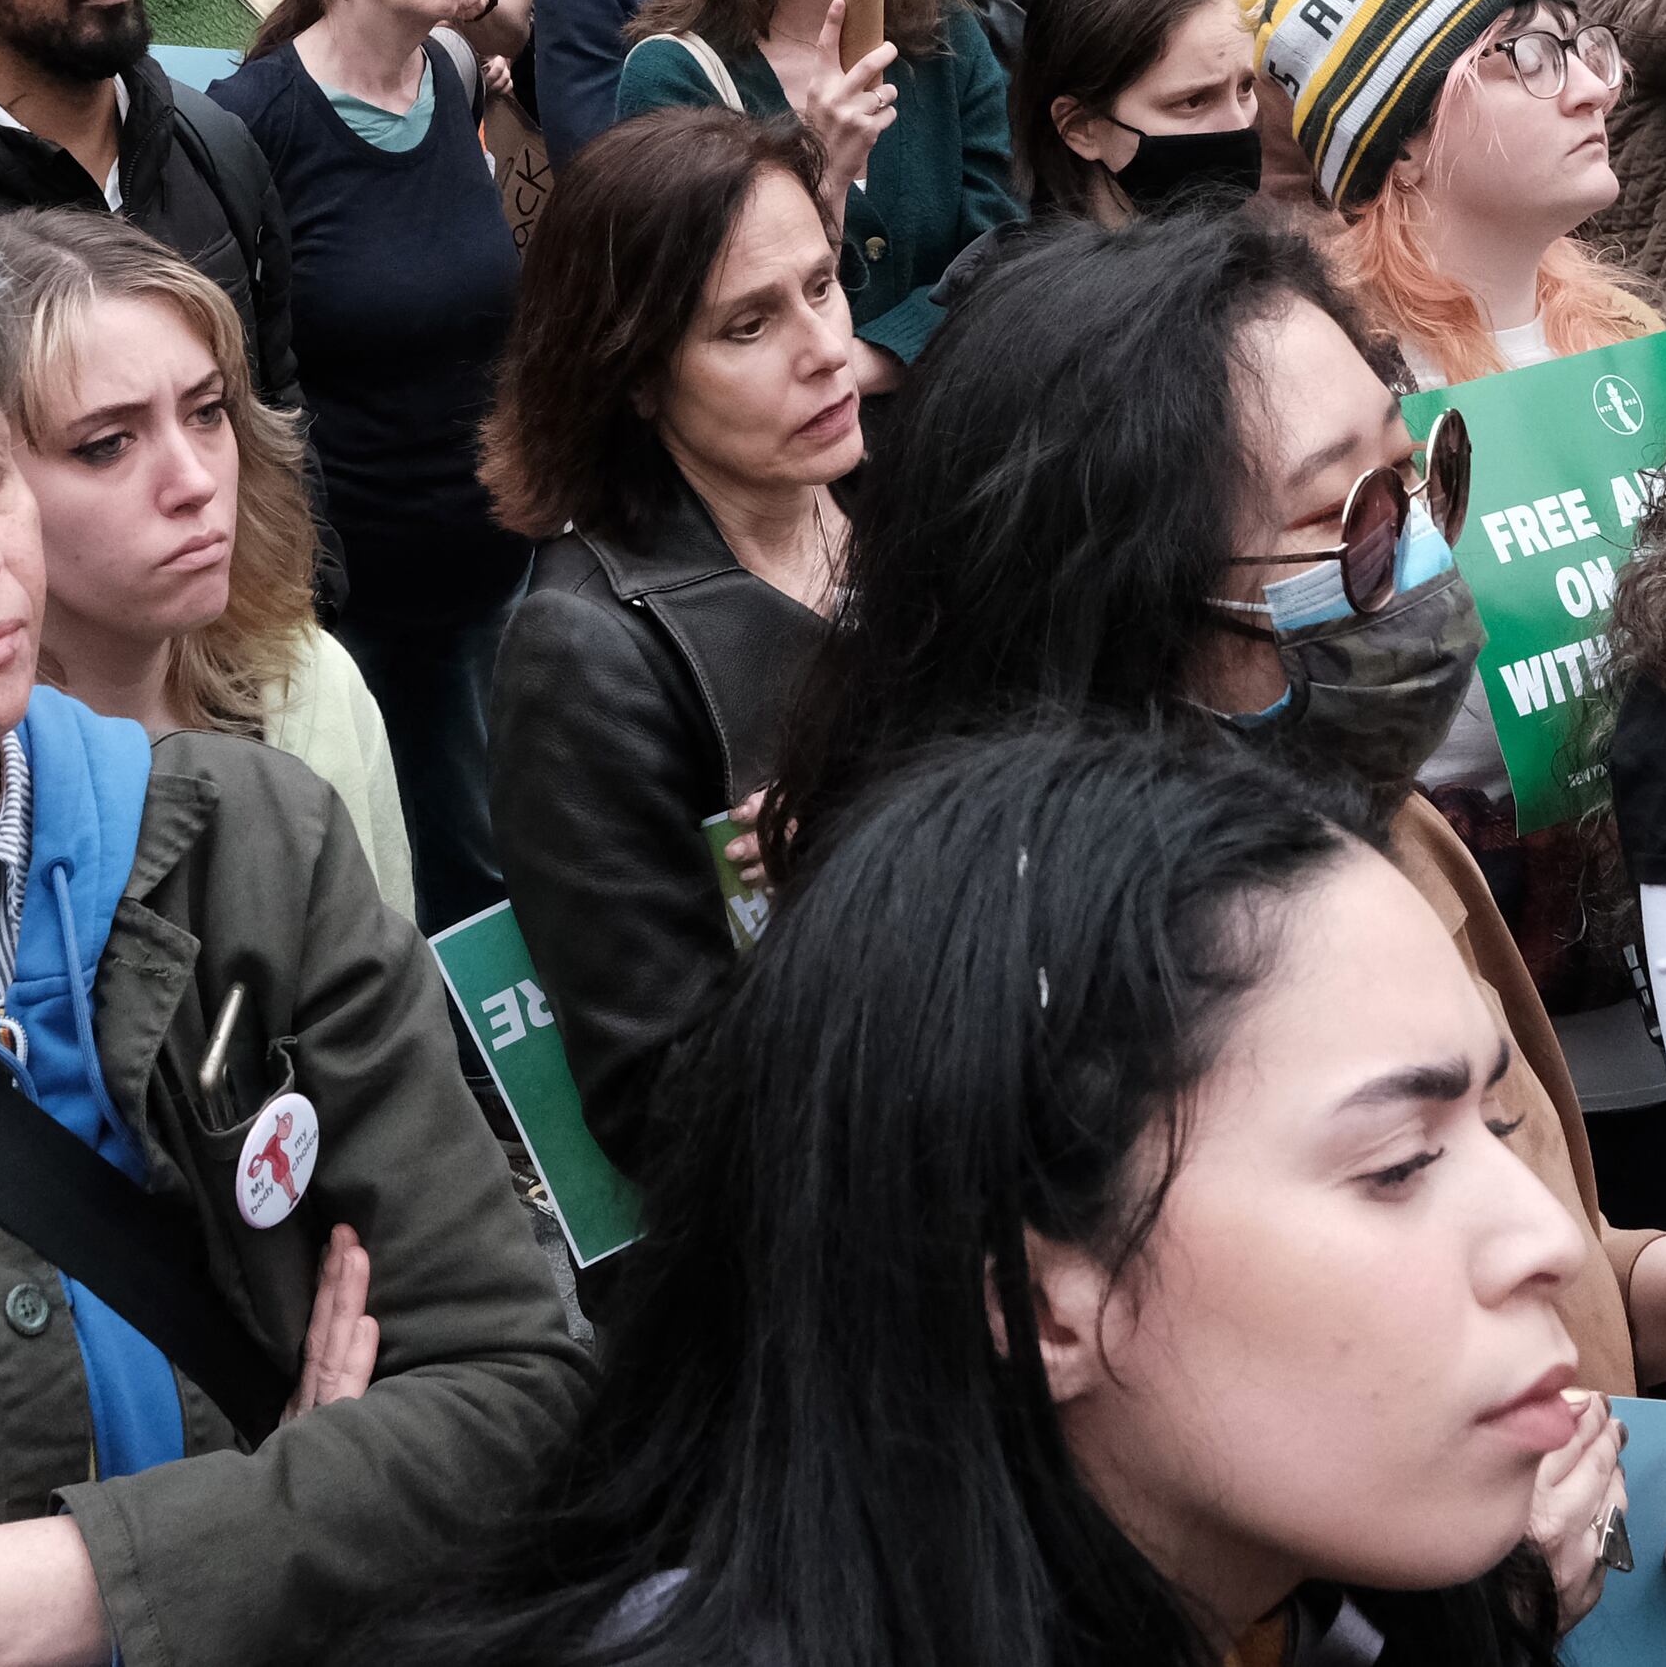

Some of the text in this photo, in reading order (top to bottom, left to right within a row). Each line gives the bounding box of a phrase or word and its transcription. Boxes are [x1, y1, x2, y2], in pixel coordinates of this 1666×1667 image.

[1480, 487, 1600, 565] FREE
[1555, 555, 1617, 620] ON
[292, 1128, 319, 1173] choice
[294, 1127, 309, 1150] my
[250, 1176, 266, 1198] My
[250, 1182, 275, 1216] body
